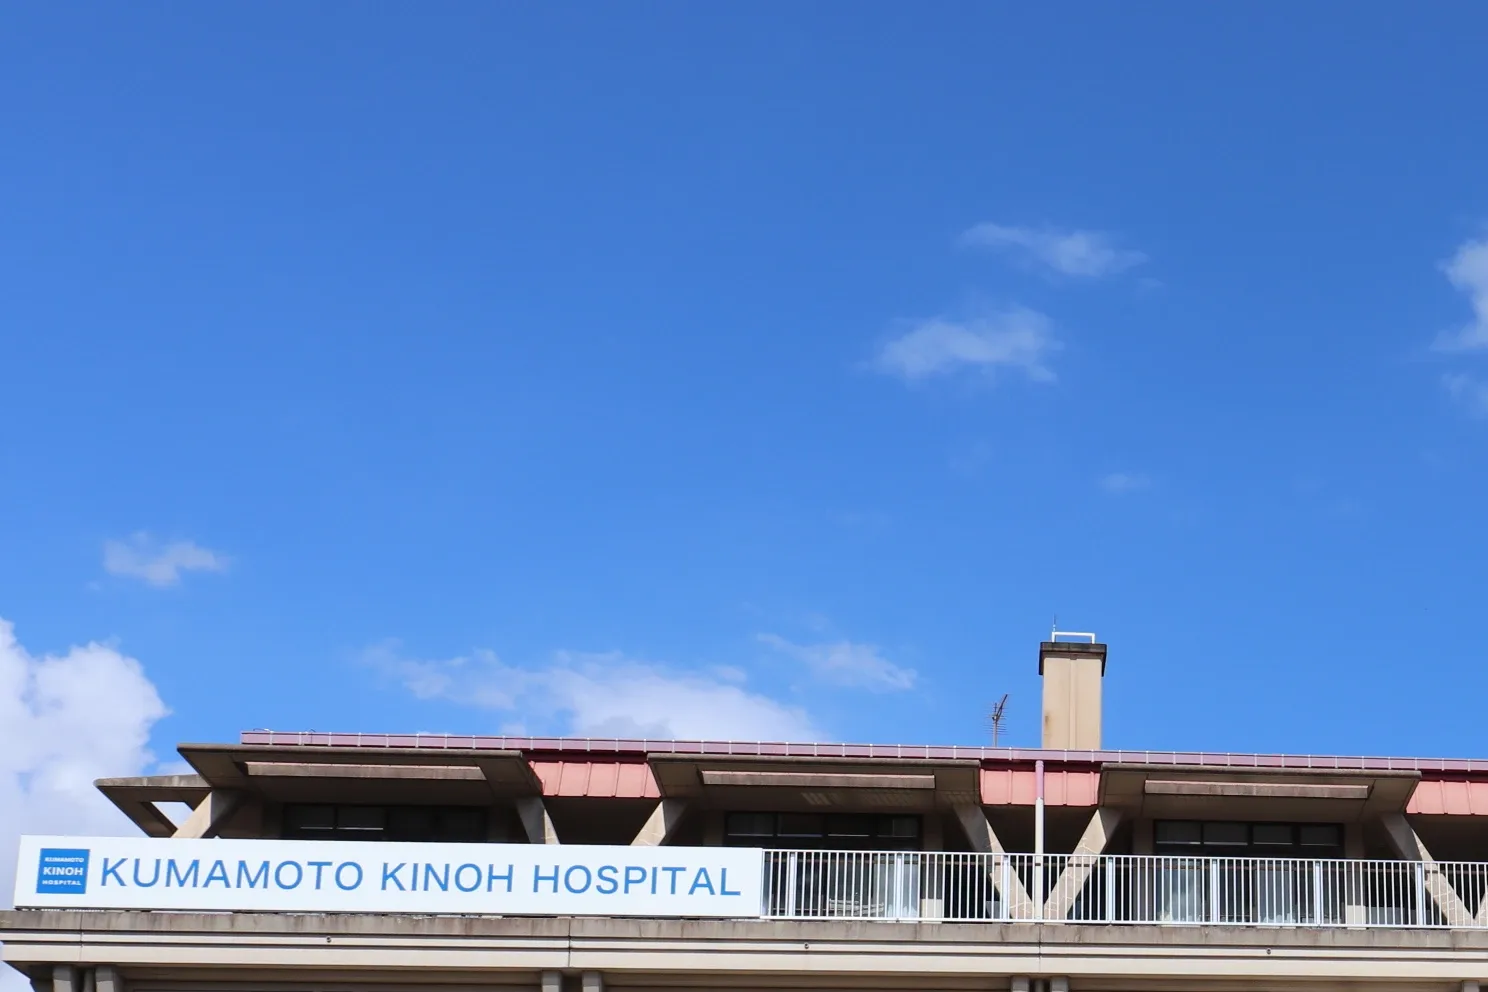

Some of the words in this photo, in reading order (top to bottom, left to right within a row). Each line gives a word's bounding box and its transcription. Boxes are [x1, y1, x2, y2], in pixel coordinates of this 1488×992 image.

[43, 866, 84, 876] KINOH
[100, 857, 364, 892] KUMAMOTO
[380, 862, 514, 893] KINOH
[532, 864, 742, 896] HOSPITAL
